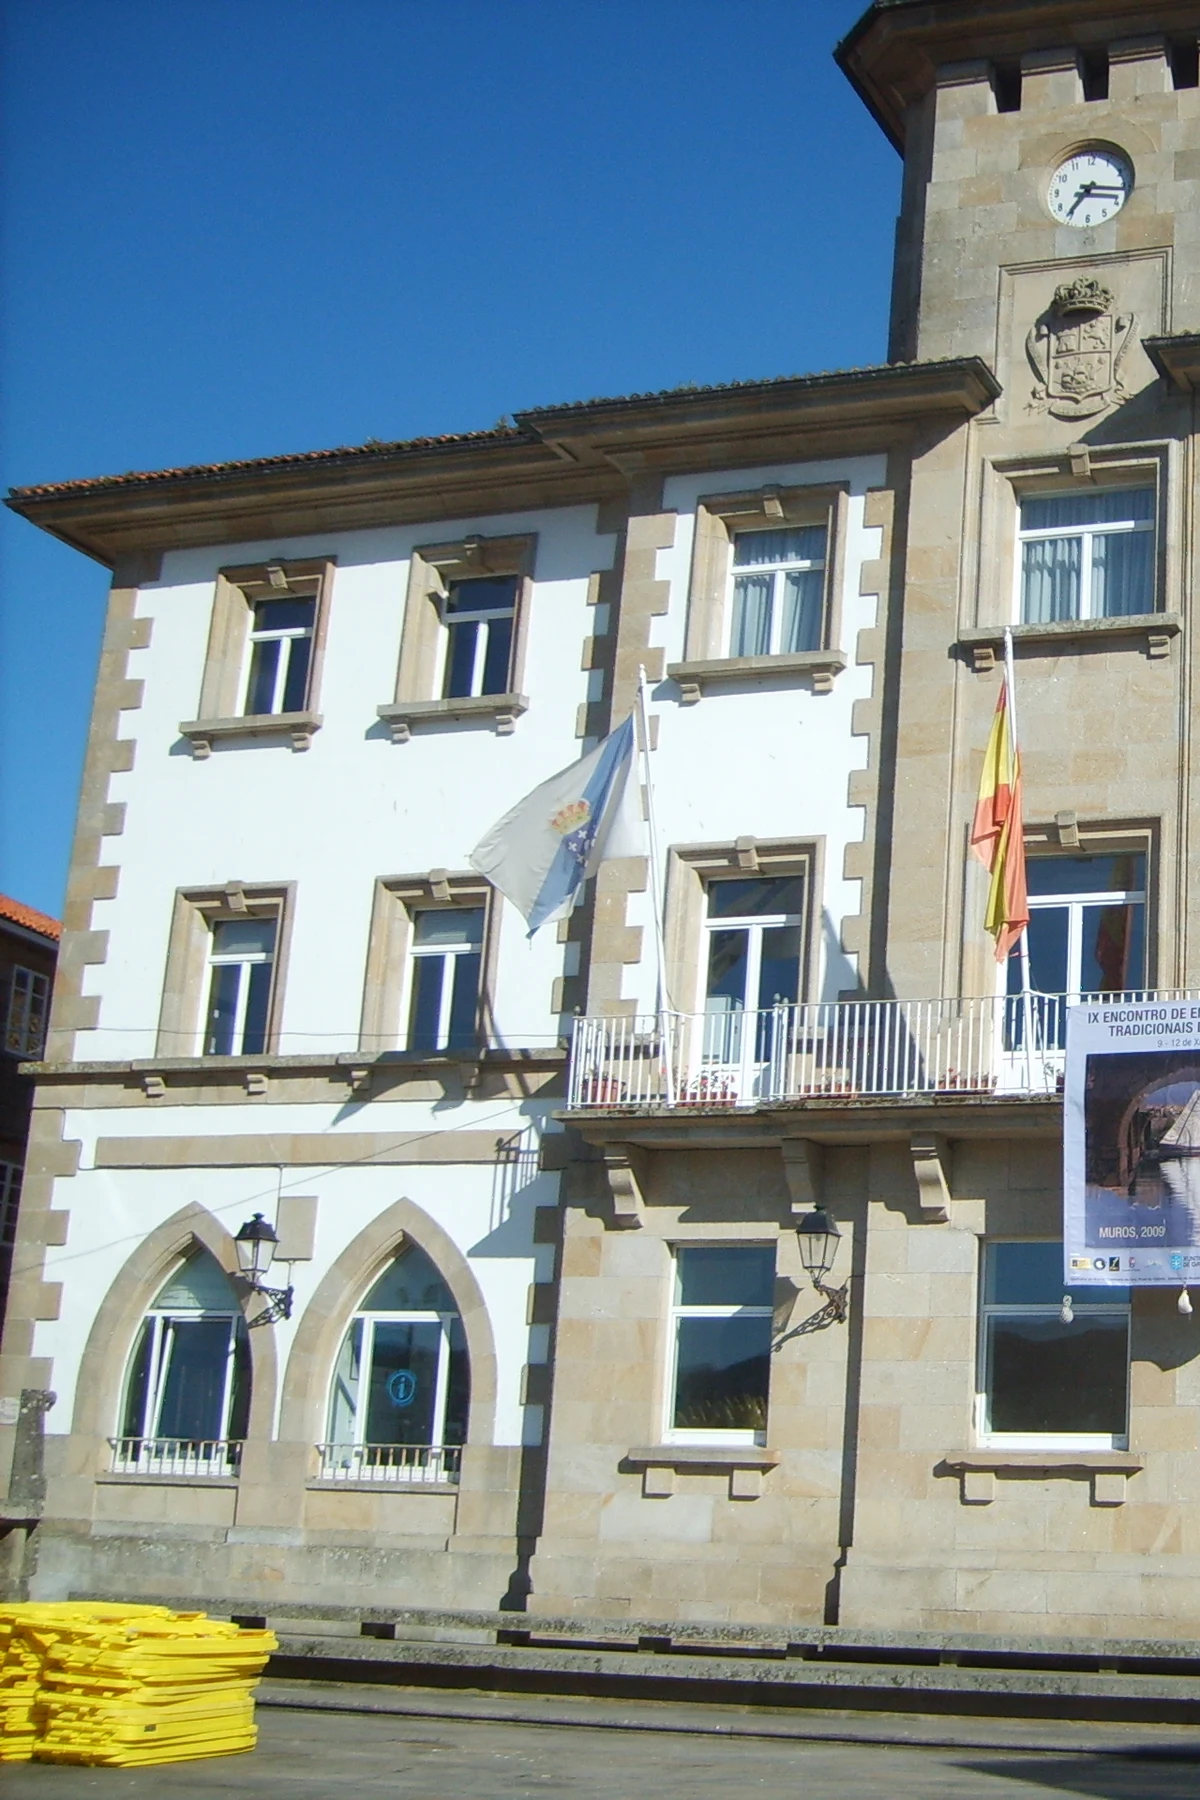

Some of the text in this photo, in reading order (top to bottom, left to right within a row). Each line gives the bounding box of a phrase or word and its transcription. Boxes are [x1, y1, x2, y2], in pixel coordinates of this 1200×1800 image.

[1071, 160, 1079, 171] 11
[1087, 156, 1096, 166] 12
[1058, 173, 1068, 183] 10
[1054, 188, 1060, 198] 9
[1057, 202, 1063, 212] 8
[1101, 208, 1108, 218] 5
[1085, 214, 1091, 223] 6
[1087, 1012, 1099, 1024] IX
[1103, 1009, 1167, 1023] ENCONTRO
[1171, 1008, 1187, 1019] DE
[1108, 1021, 1193, 1037] TRADICIONAIS
[1171, 1038, 1181, 1047] 12
[1182, 1038, 1192, 1047] de
[1099, 1226, 1166, 1240] MUROS, 2009
